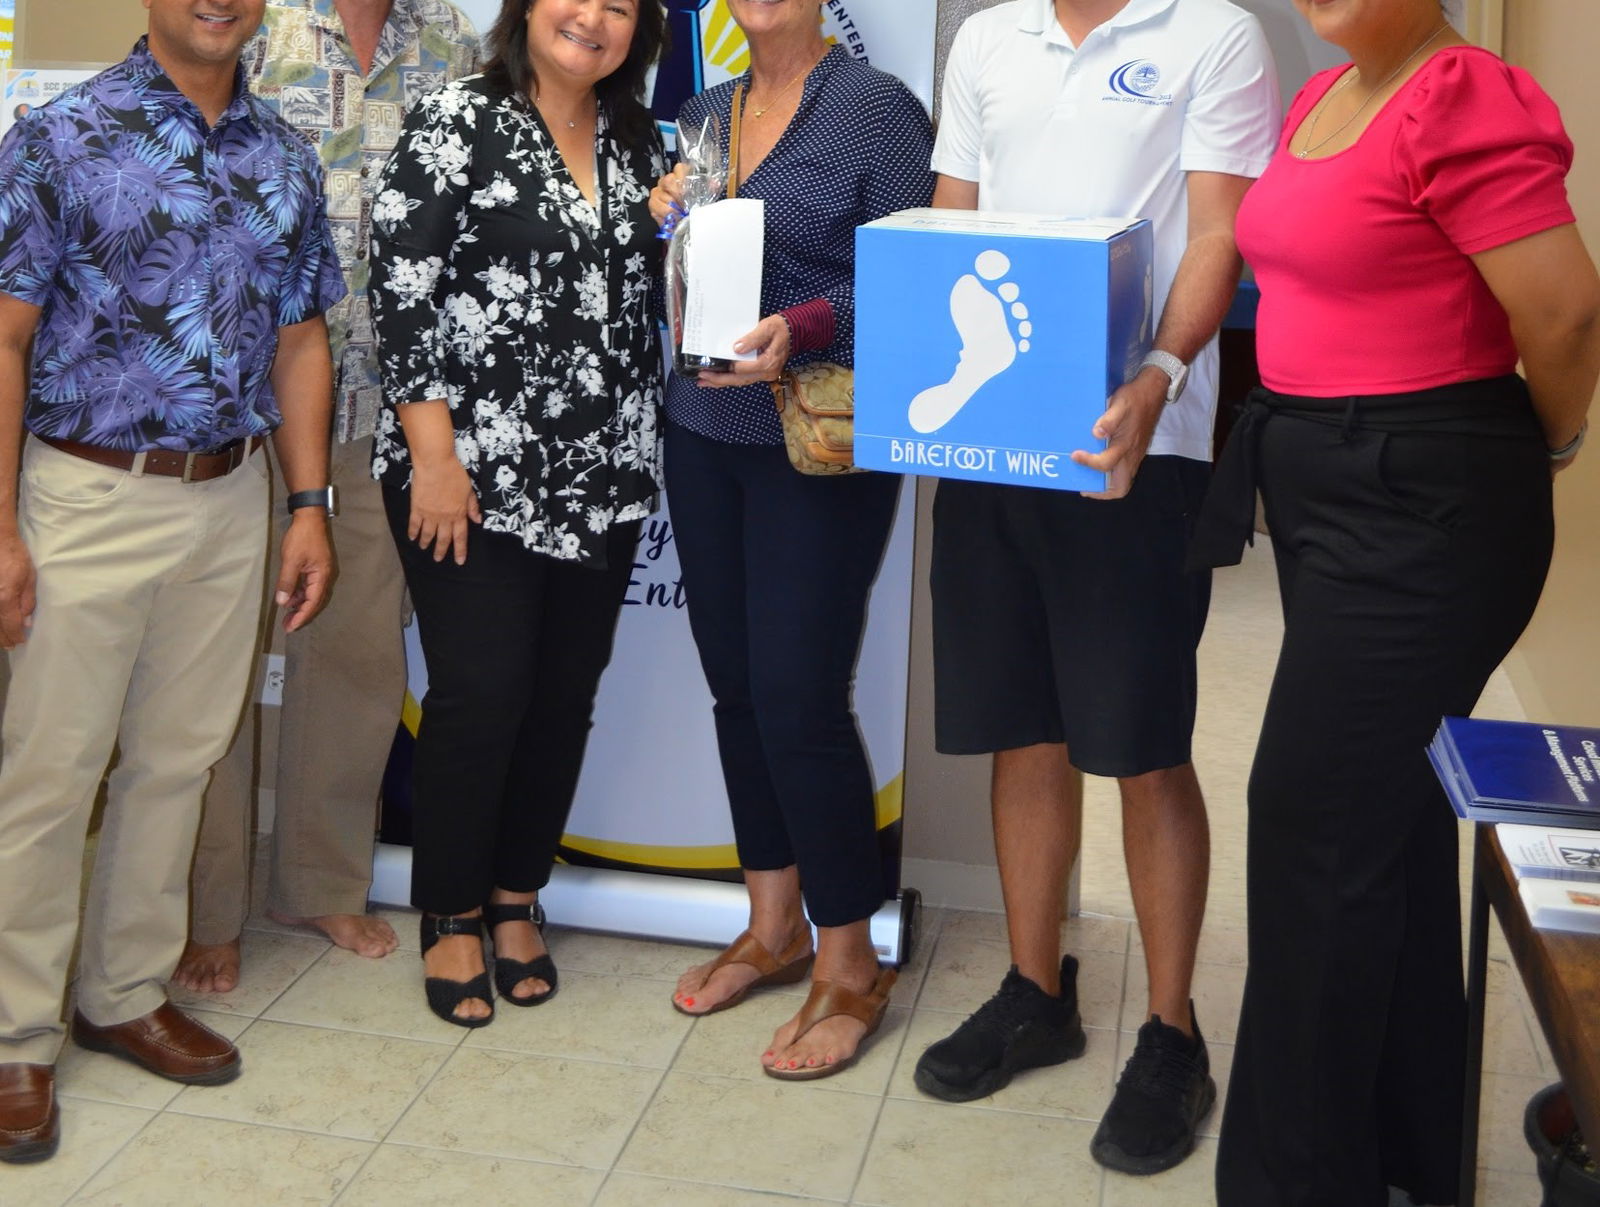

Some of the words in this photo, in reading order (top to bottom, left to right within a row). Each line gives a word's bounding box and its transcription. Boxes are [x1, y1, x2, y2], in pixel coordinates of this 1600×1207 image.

[43, 82, 60, 91] SCC
[890, 439, 996, 472] BAREFOOT
[1005, 450, 1060, 478] WINE
[1544, 735, 1574, 775] Management
[1572, 756, 1595, 782] Services
